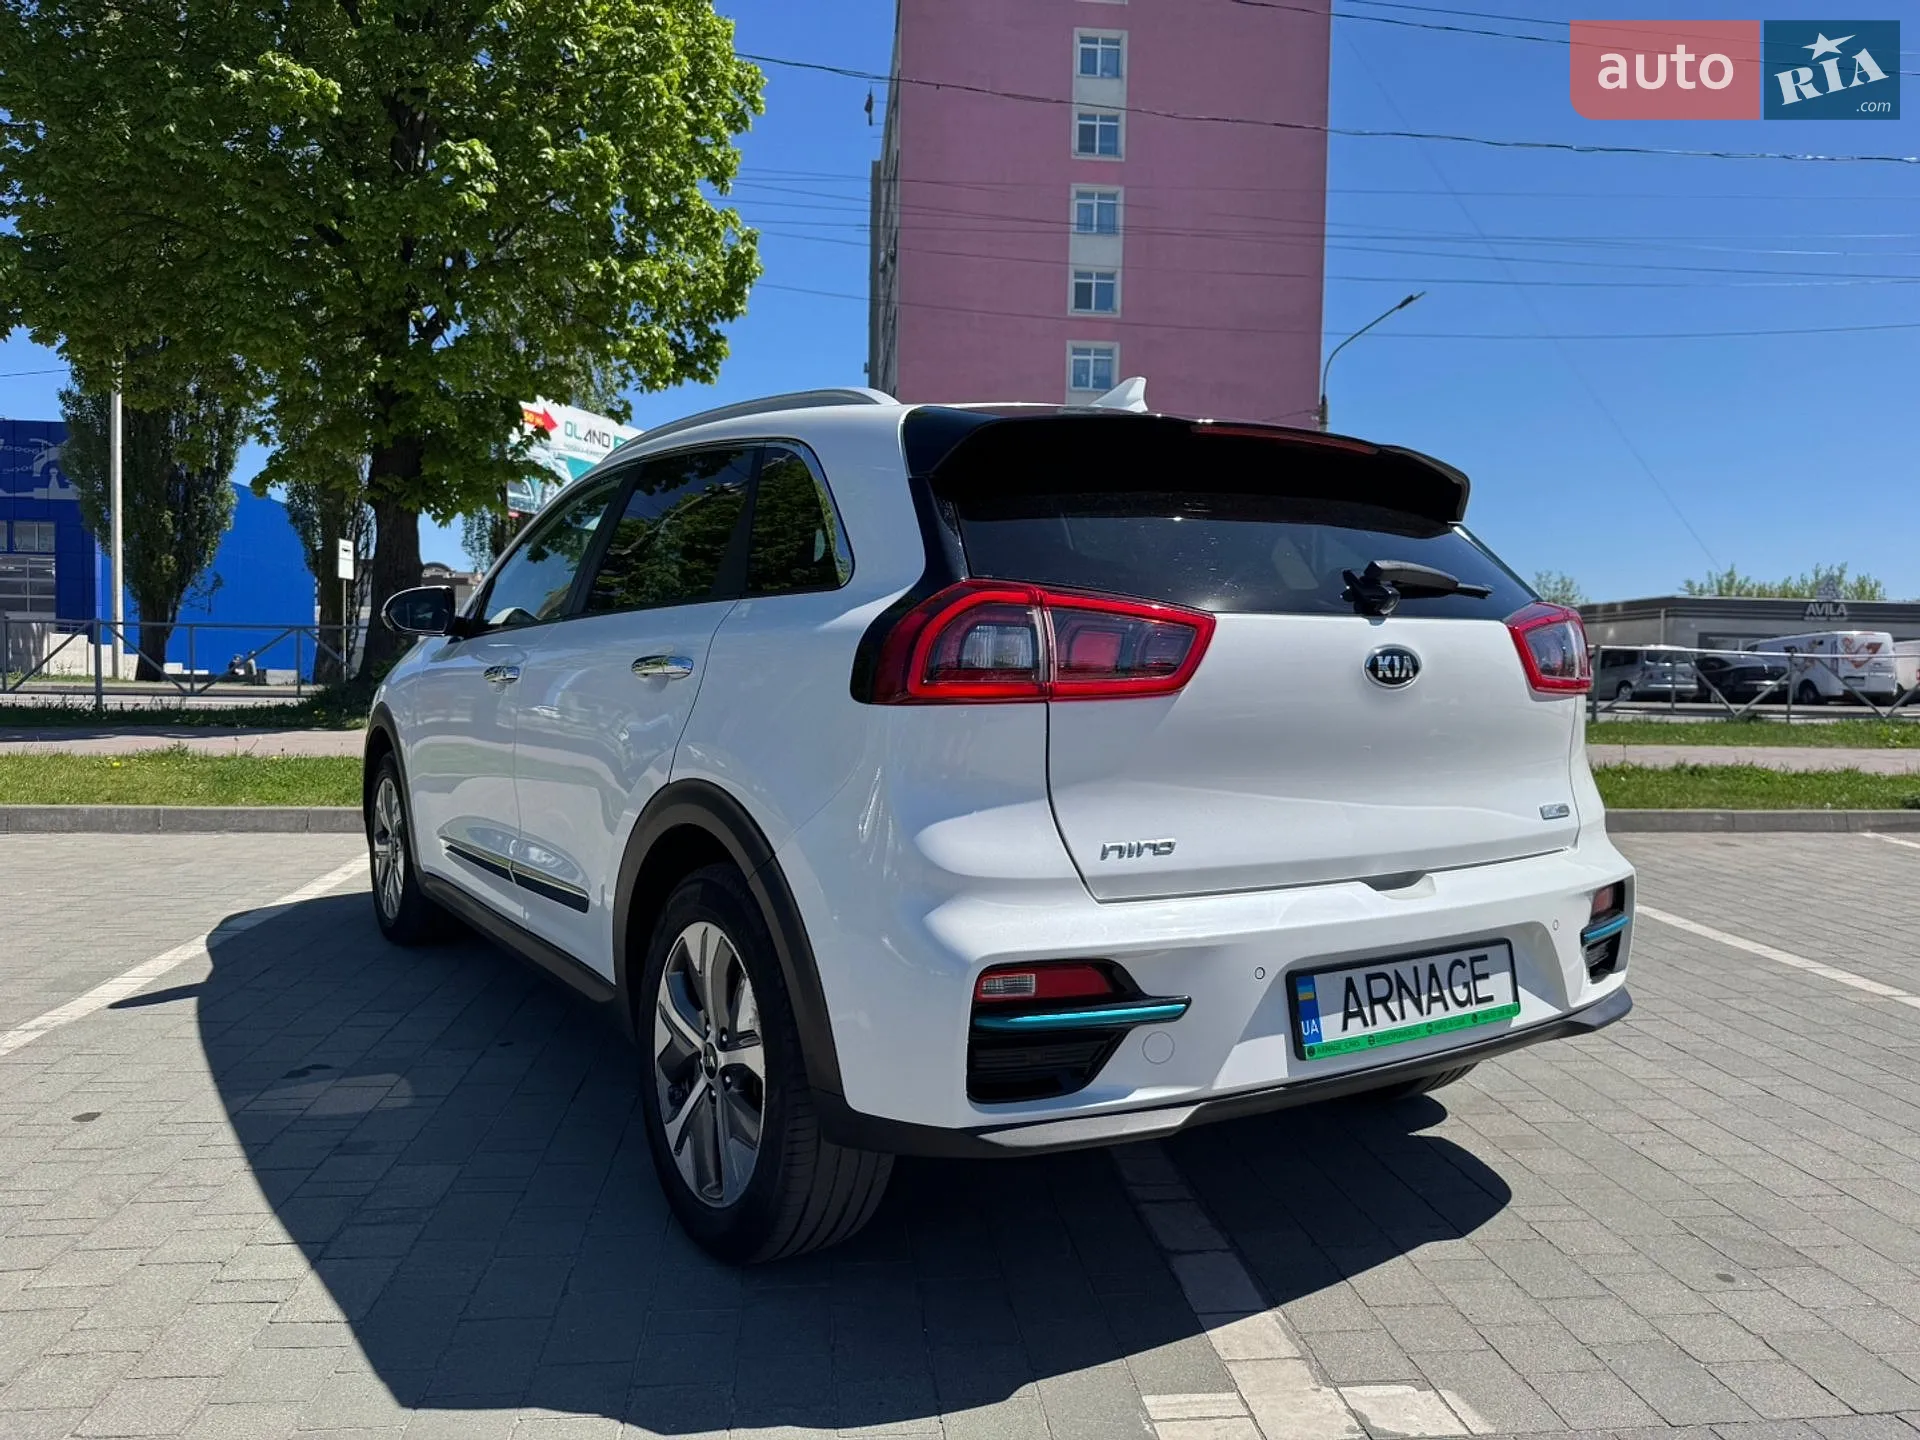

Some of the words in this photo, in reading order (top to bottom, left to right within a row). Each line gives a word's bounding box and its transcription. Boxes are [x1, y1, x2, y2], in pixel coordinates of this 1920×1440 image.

[1805, 603, 1849, 616] AVILA
[1376, 655, 1414, 678] KIA
[1341, 954, 1494, 1032] ARNAGE
[1301, 1018, 1320, 1037] UA
